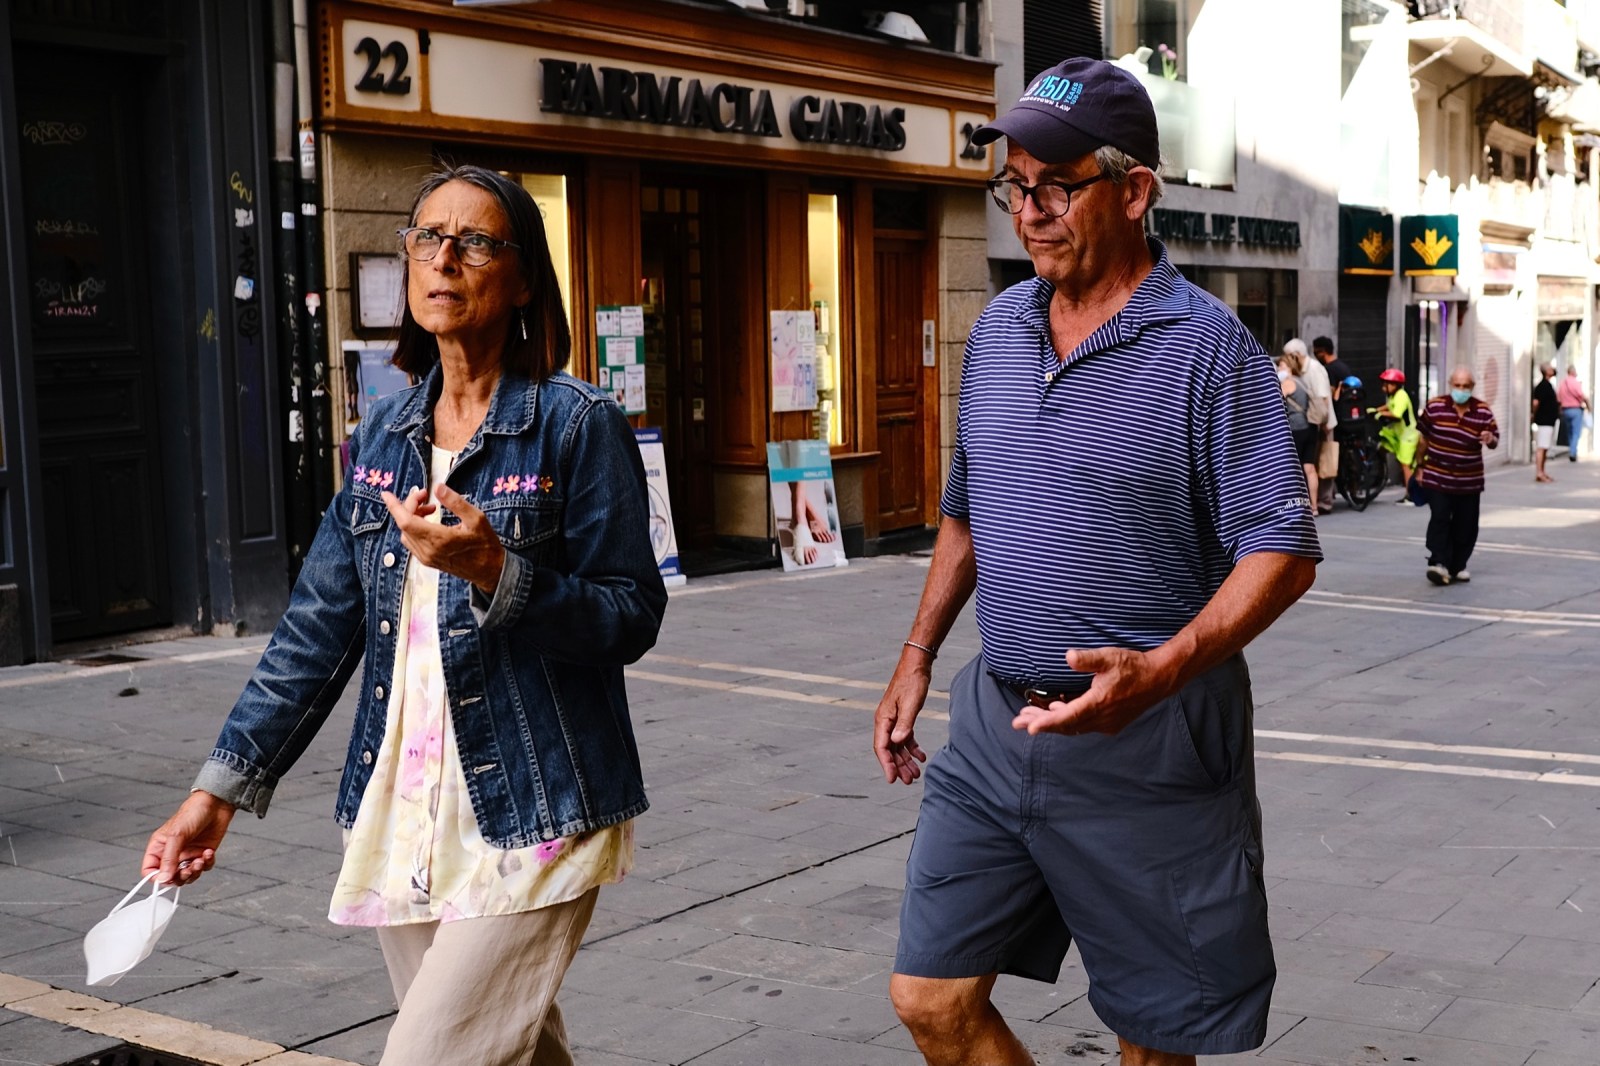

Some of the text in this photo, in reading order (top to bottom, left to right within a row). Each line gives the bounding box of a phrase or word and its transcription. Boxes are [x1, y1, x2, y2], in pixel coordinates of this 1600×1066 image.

[354, 37, 411, 94] 22
[538, 58, 906, 151] FARMACIA GABAS
[1033, 75, 1071, 101] 150
[1055, 101, 1071, 112] LAW
